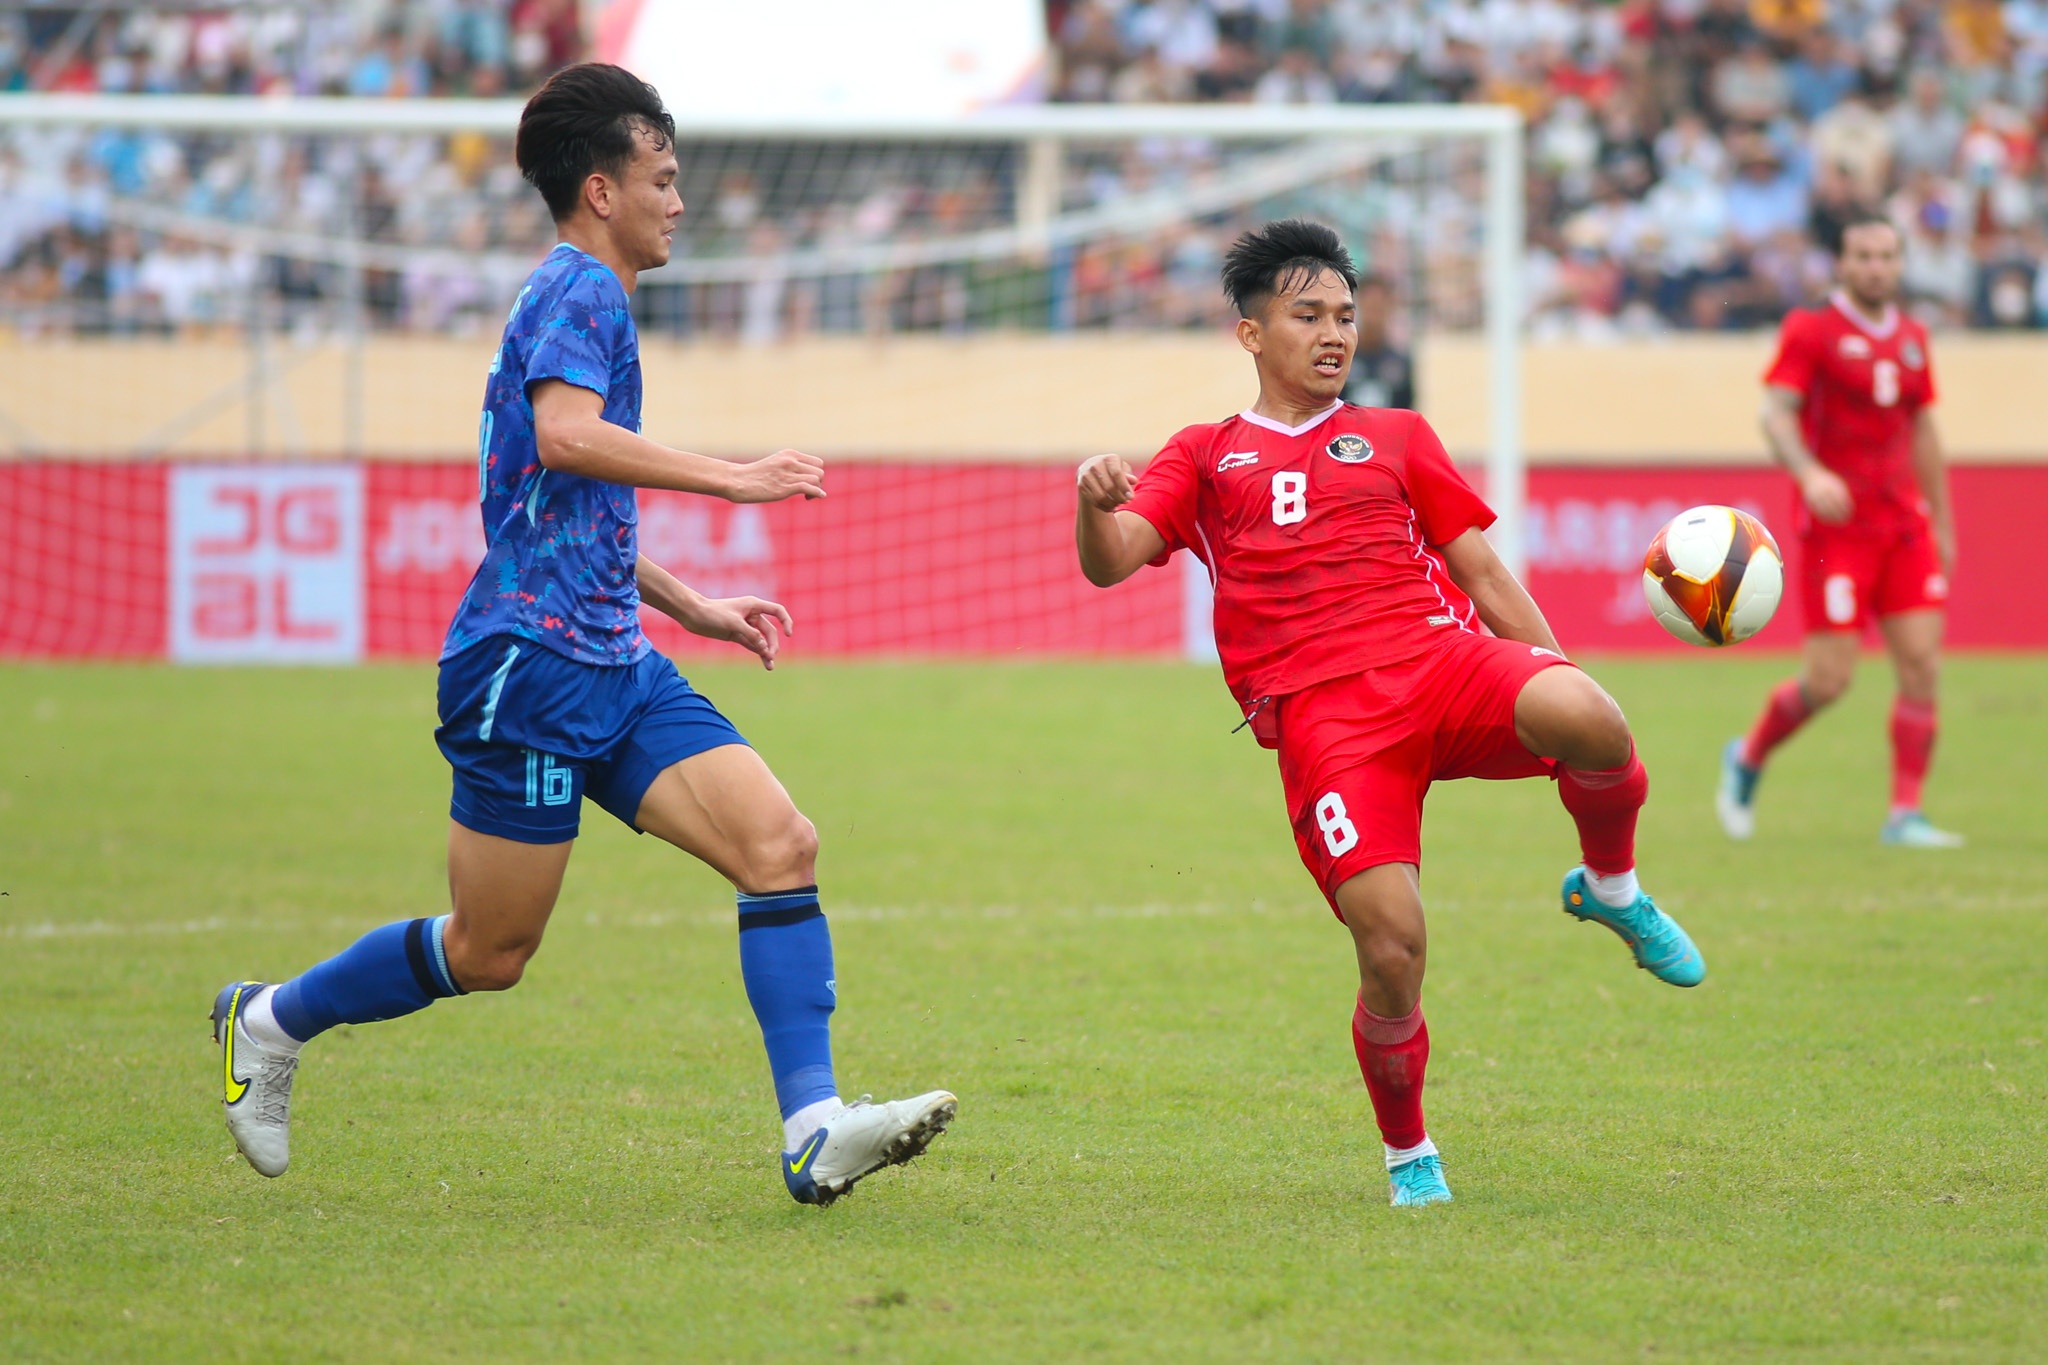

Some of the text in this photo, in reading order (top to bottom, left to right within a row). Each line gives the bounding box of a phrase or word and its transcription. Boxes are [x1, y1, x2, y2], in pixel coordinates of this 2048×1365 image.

[1271, 470, 1307, 526] 8
[520, 747, 573, 807] 16
[1315, 791, 1360, 858] 8
